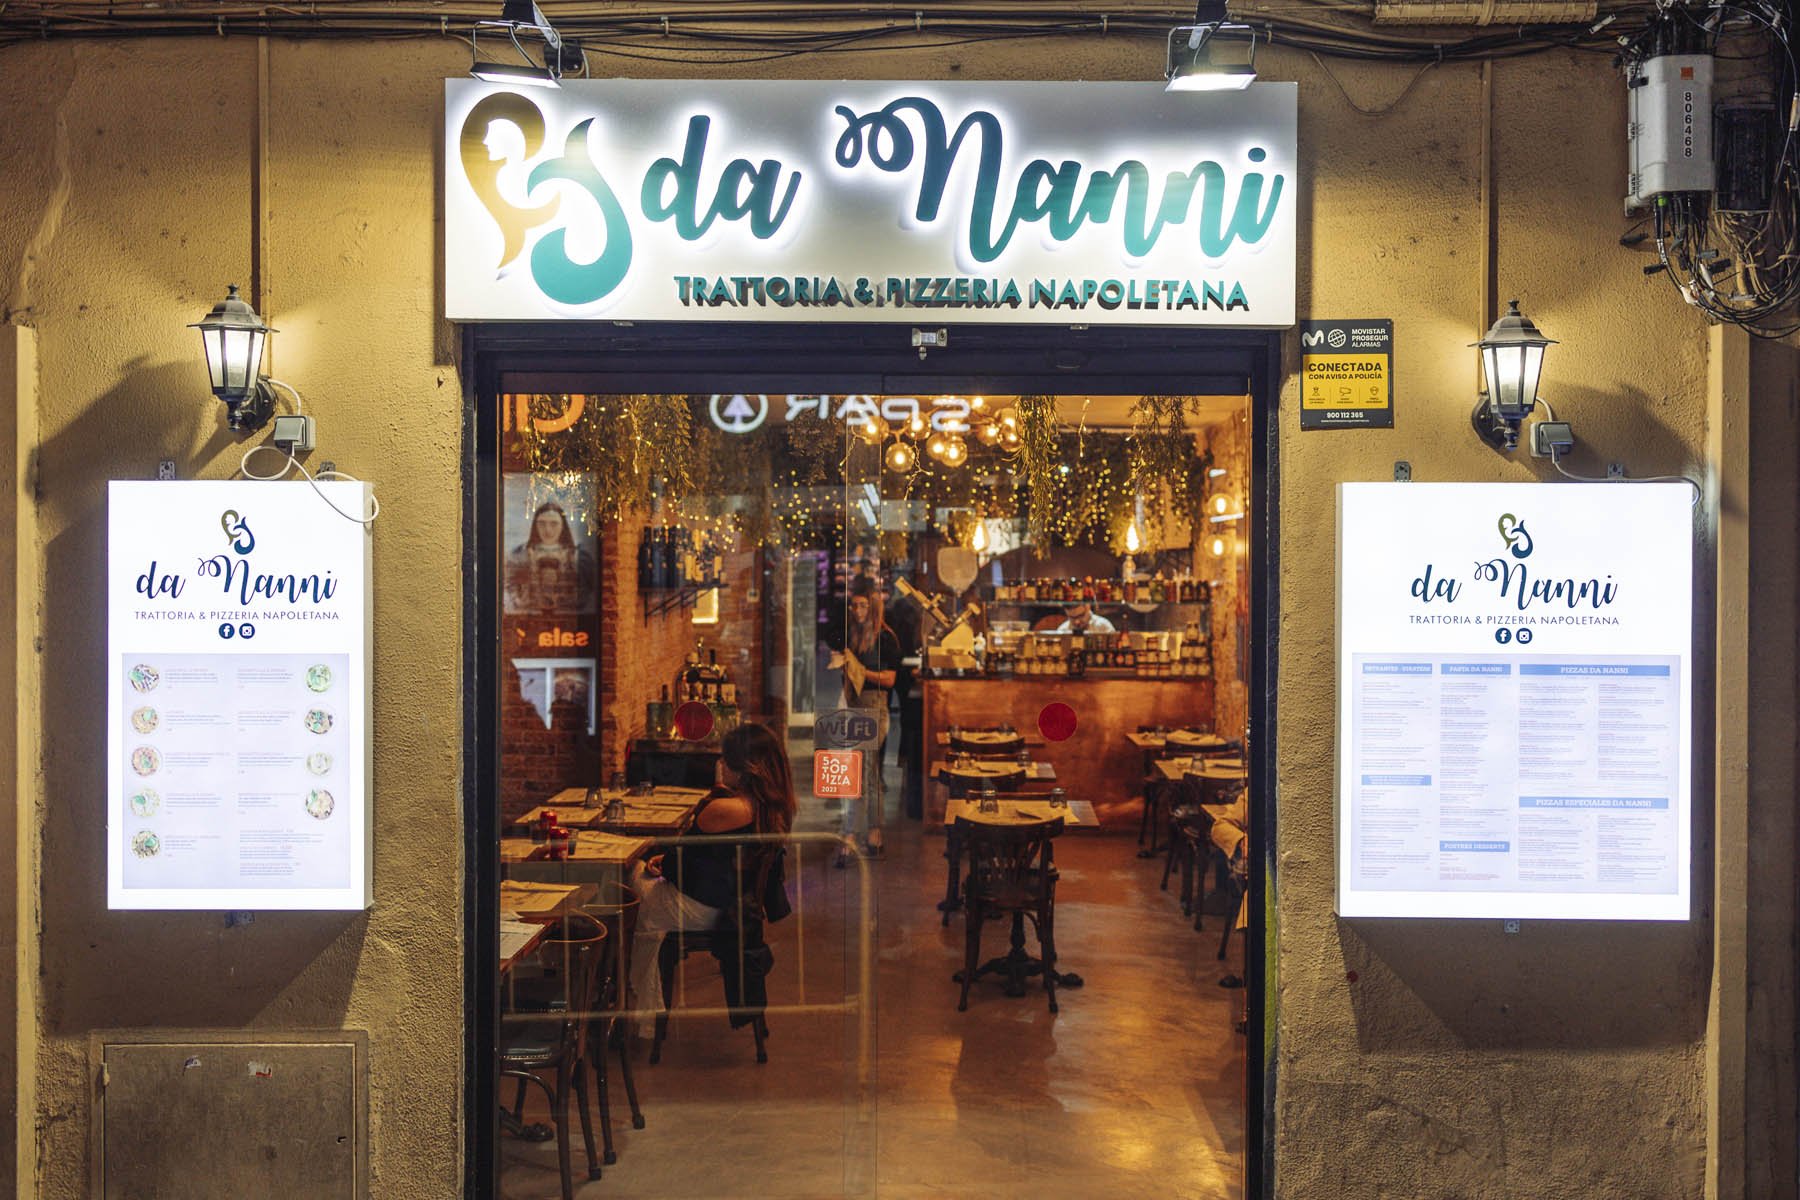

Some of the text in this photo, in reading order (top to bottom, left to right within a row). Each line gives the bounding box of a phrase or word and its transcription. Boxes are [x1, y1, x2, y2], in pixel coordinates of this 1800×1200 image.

[1684, 91, 1693, 158] 806468
[641, 96, 1285, 264] da Nanni
[673, 276, 1249, 306] TRATTORIA & PIZZERIA NAPOLETANA
[1308, 362, 1382, 372] CONECTADA
[1354, 371, 1382, 380] POLICÍA
[1340, 411, 1350, 419] 112
[136, 555, 338, 606] da Nanni
[1411, 558, 1619, 610] da Nanni
[134, 610, 340, 621] TRATTORIA & PIZZERIA NAPOLETANA
[1409, 614, 1619, 626] TRATTORIA & PIZZERIA NAPOLETANA
[822, 764, 848, 775] TOP
